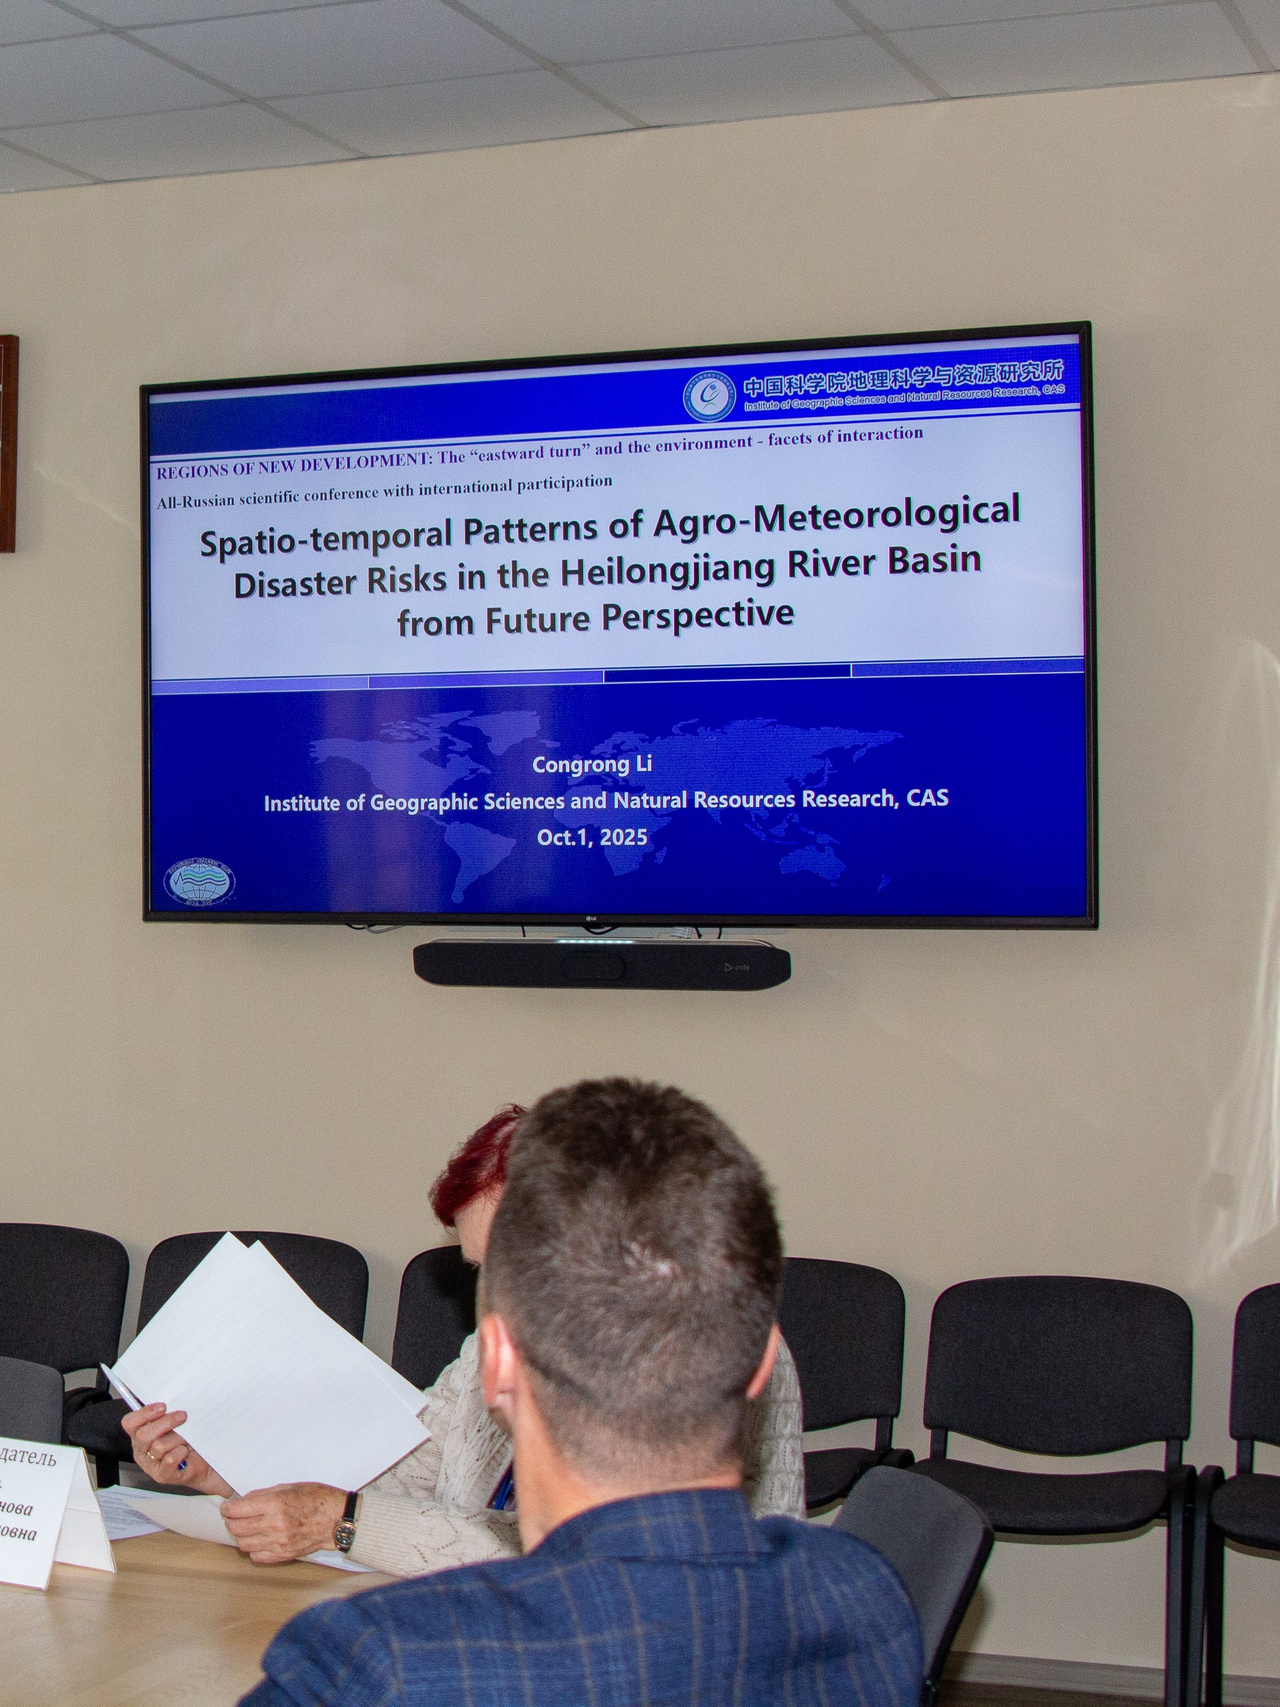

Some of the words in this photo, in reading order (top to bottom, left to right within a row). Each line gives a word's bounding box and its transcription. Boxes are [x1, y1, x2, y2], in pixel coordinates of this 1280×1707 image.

[743, 359, 1064, 397] 中国科学院地理科学与资源研究所
[744, 400, 780, 412] Institute
[781, 400, 791, 410] of
[791, 397, 844, 410] Geographic
[845, 394, 886, 406] Sciences
[887, 392, 905, 403] and
[907, 391, 940, 403] Natural
[942, 388, 991, 400] Resources
[993, 386, 1041, 398] Research,
[1042, 384, 1065, 395] CAS
[156, 464, 229, 480] REGIONS
[233, 462, 255, 476] OF
[258, 459, 297, 475] NEW
[300, 451, 433, 473] DEVELOPMENT:
[437, 451, 466, 465] The
[595, 441, 623, 456] and
[628, 440, 651, 454] the
[655, 434, 753, 452] environment
[768, 433, 812, 447] facets
[817, 430, 835, 444] of
[837, 426, 924, 443] interaction
[156, 494, 235, 510] All-Russian
[239, 490, 300, 506] scientific
[304, 487, 379, 502] conference
[383, 484, 414, 498] with
[419, 478, 512, 496] international
[517, 474, 613, 495] participation
[200, 518, 453, 564] Spatio-temporal
[464, 514, 598, 546] Patterns
[609, 508, 644, 539] of
[654, 492, 1021, 544] Agro-Meteorological
[235, 569, 358, 599] Disaster
[368, 565, 448, 594] Risks
[457, 562, 487, 591] in
[496, 560, 550, 589] the
[561, 552, 776, 591] Heilongjiang
[788, 548, 877, 578] River
[888, 543, 983, 575] Basin
[397, 609, 474, 638] from
[486, 605, 591, 635] Future
[602, 597, 795, 638] Perspective
[532, 756, 630, 778] Congrong
[636, 754, 653, 773] Li
[263, 794, 341, 812] Institute
[346, 793, 367, 811] of
[370, 793, 479, 816] Geographic
[484, 791, 565, 811] Sciences
[571, 791, 607, 810] and
[614, 790, 688, 809] Natural
[694, 790, 796, 808] Resources
[802, 788, 899, 810] Research,
[906, 789, 949, 807] CAS
[537, 828, 594, 849] Oct.1,
[600, 829, 648, 847] 2025
